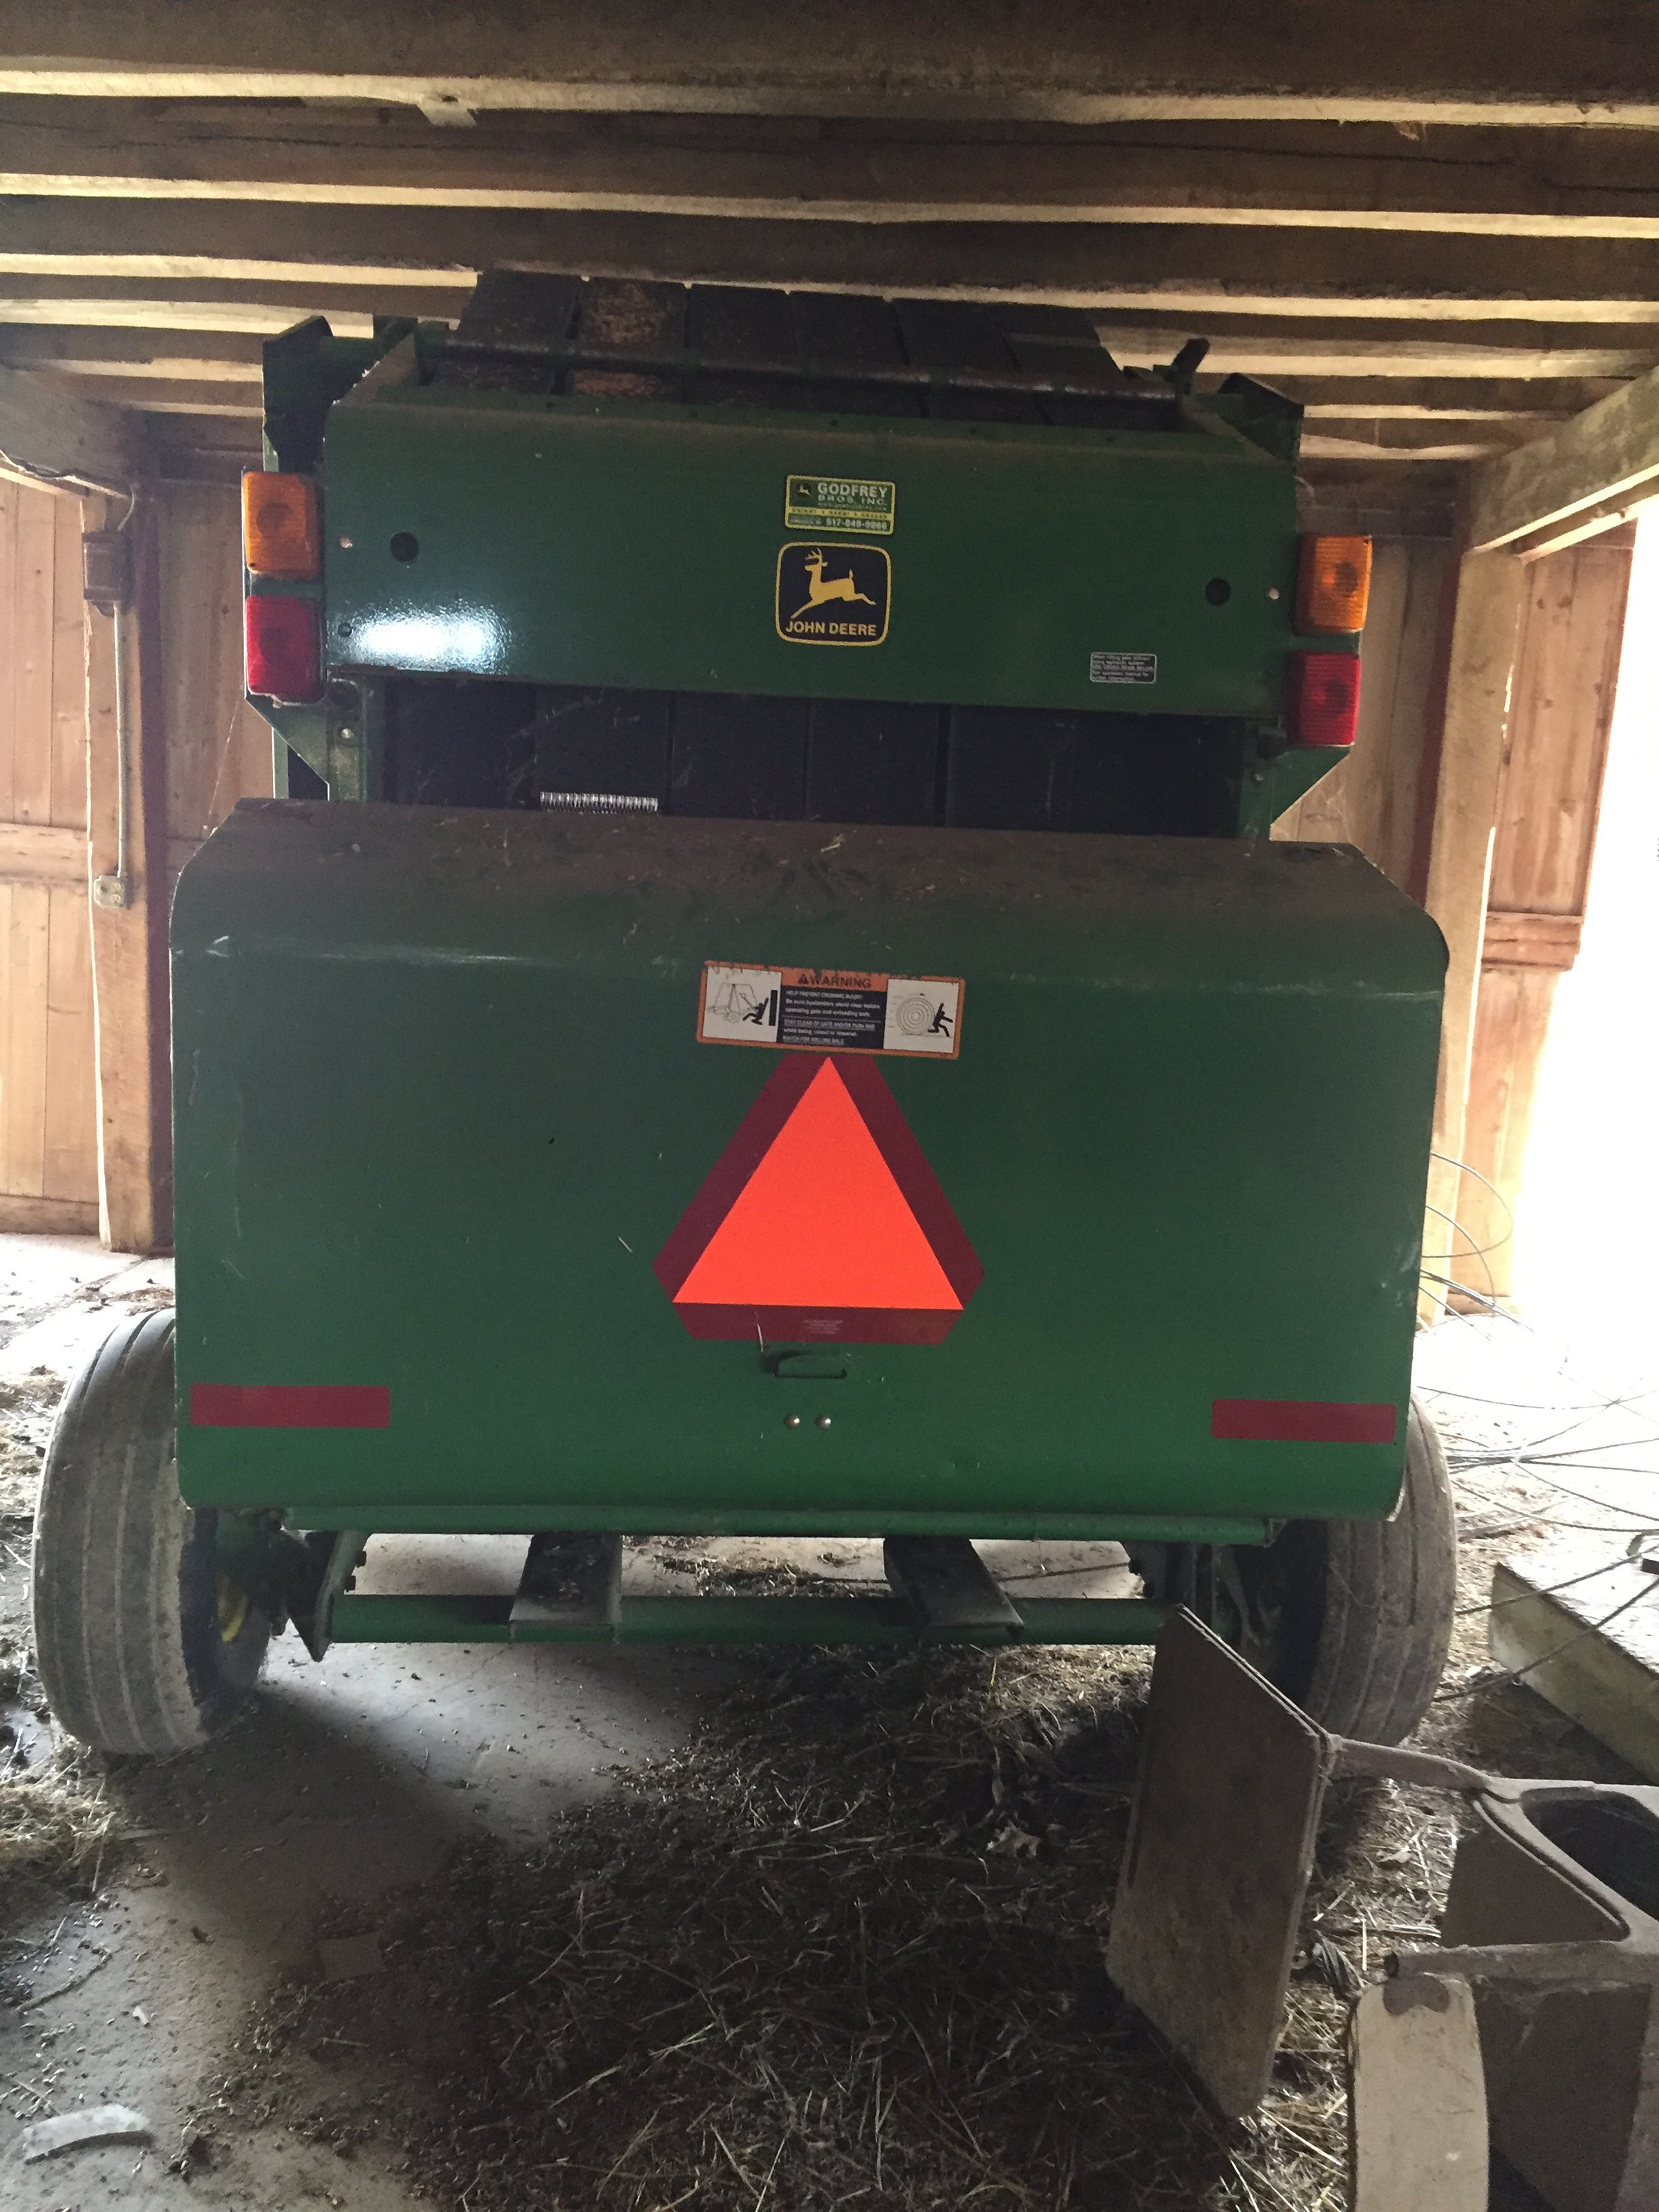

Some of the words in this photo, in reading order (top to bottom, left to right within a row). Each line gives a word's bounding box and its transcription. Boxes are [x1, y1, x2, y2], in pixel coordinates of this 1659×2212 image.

[817, 482, 888, 498] GODFREY
[861, 497, 888, 506] INC.
[785, 621, 825, 634] JOHN
[830, 622, 877, 636] DEERE
[809, 975, 872, 988] WARNING
